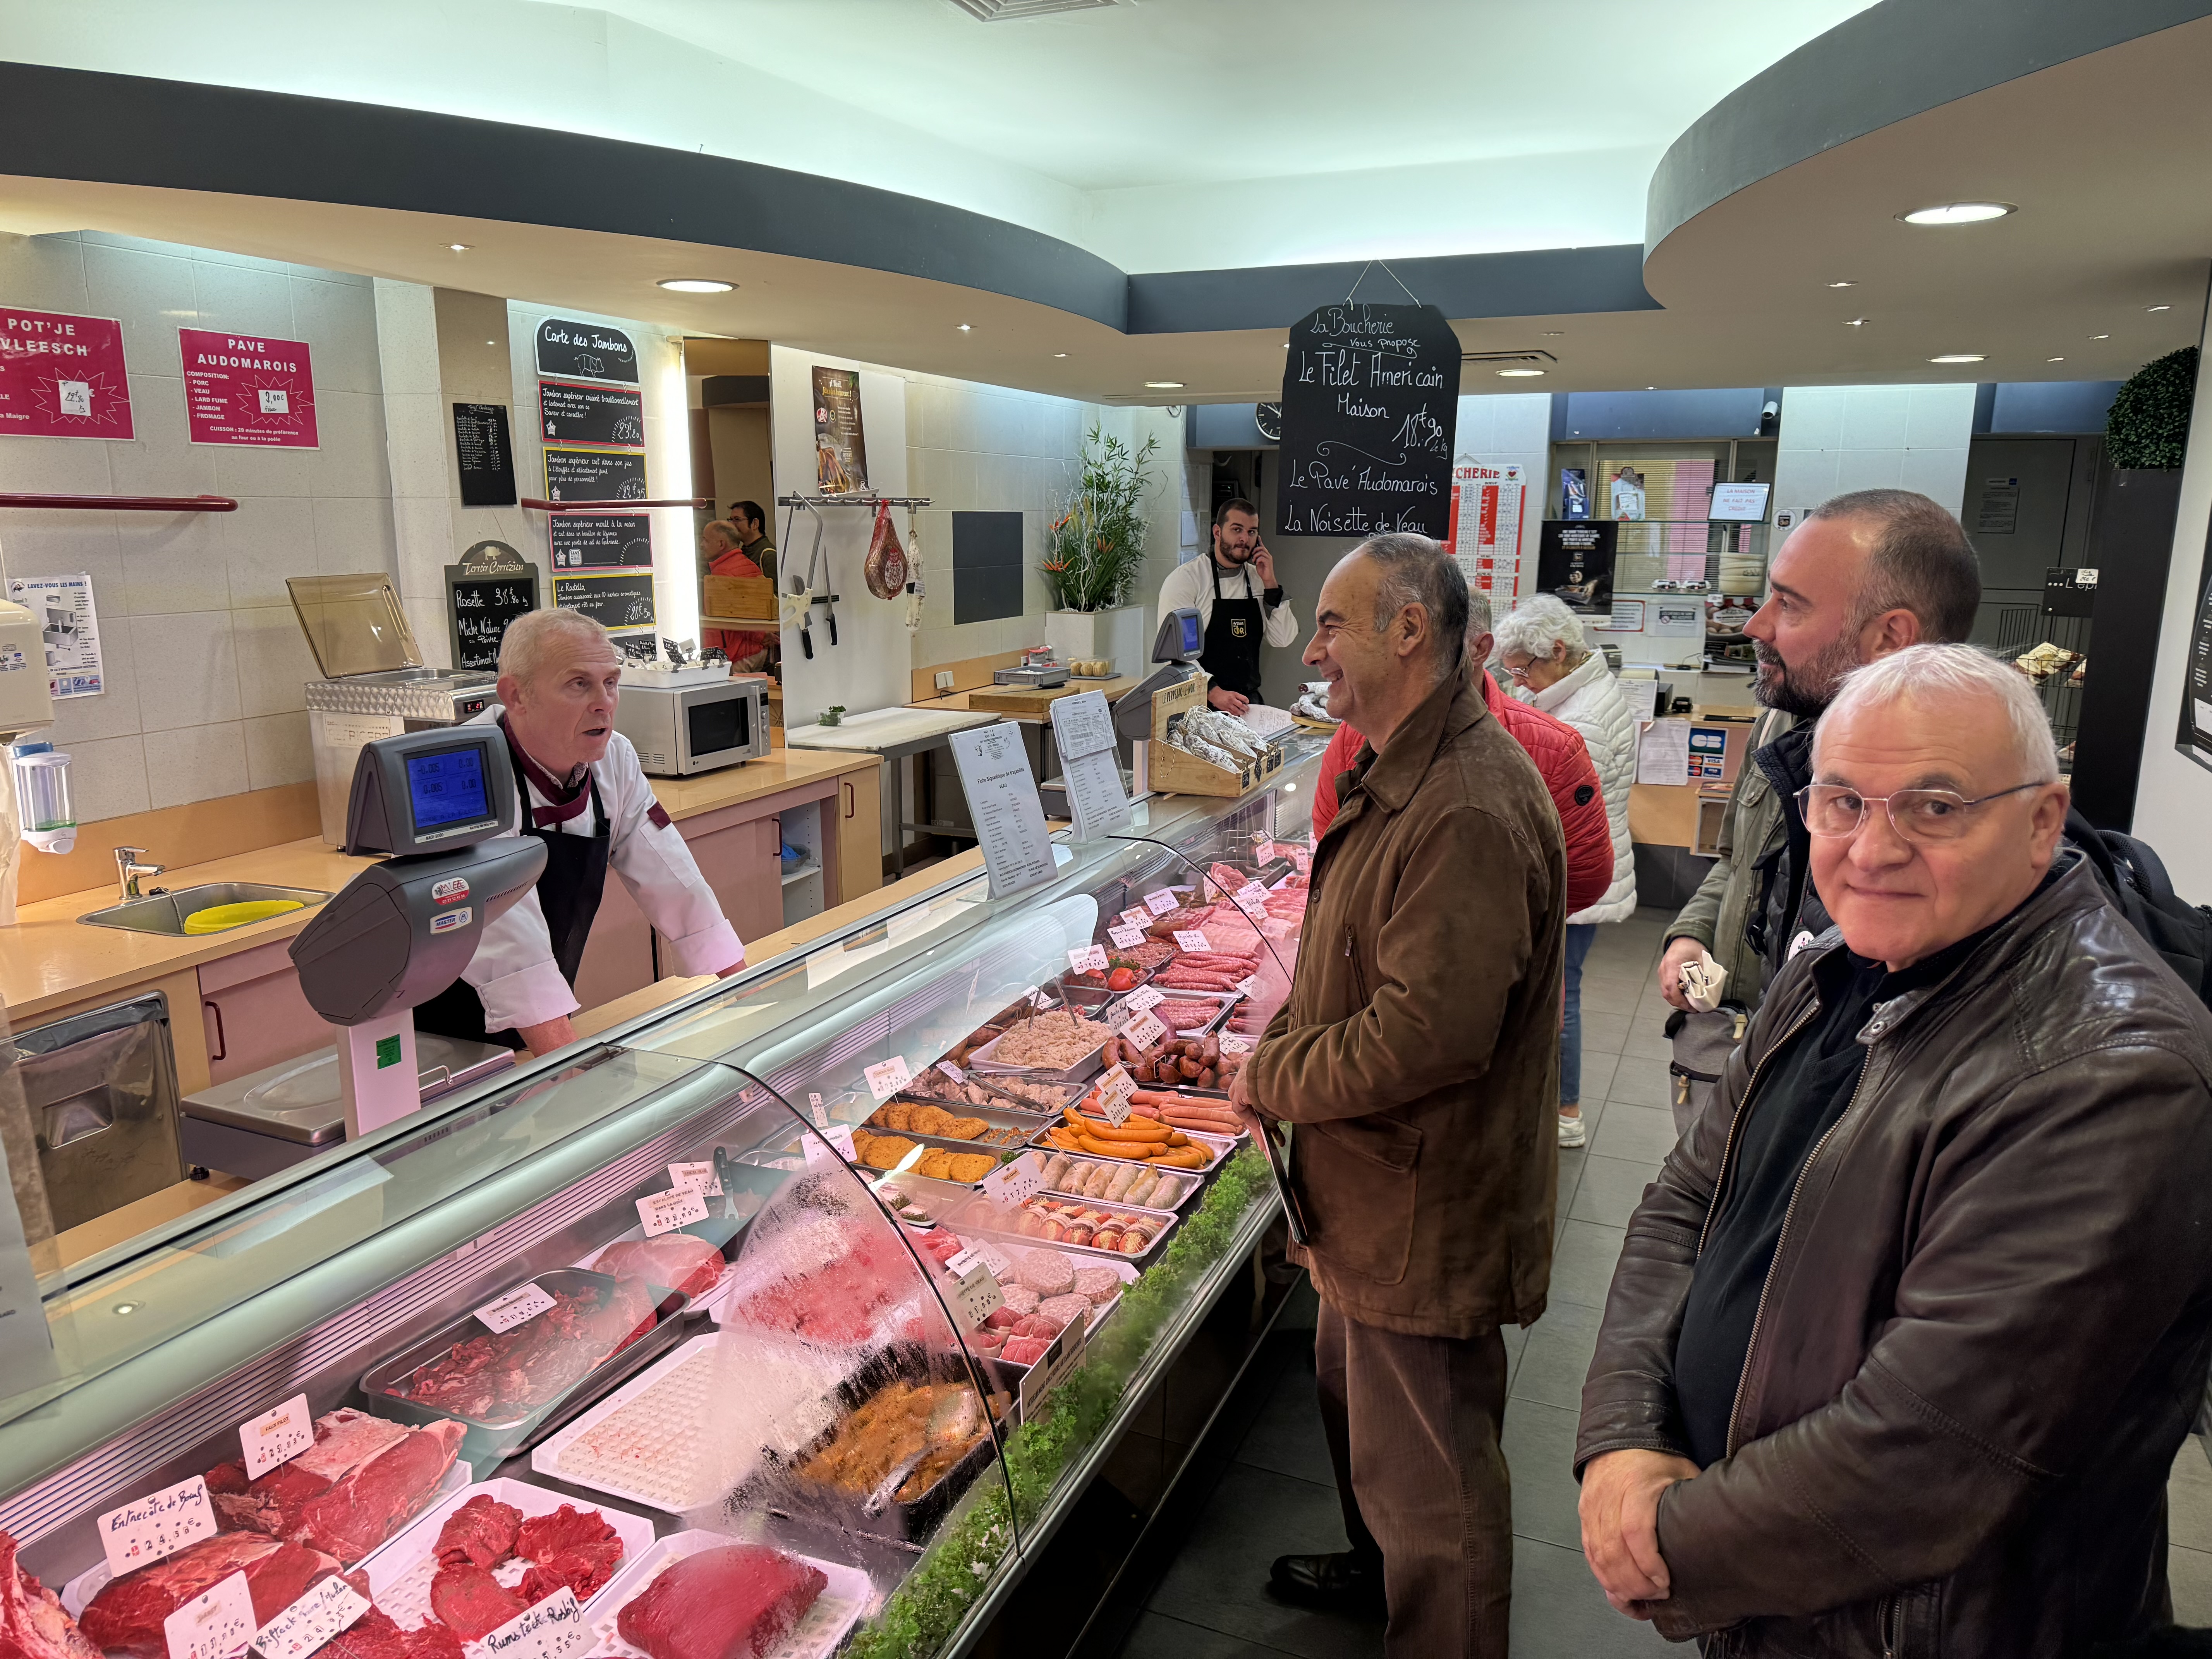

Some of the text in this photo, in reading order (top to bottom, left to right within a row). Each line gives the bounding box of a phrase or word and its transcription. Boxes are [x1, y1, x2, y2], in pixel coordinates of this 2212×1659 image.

[1310, 304, 1394, 336] La Boucherie
[228, 339, 265, 352] PAVE
[545, 326, 627, 353] Carte des Jambons
[0, 338, 88, 356] VLEESCH
[198, 354, 297, 373] AUDOMAROIS
[1299, 351, 1314, 383] Le
[1316, 349, 1360, 386] Filet
[187, 371, 229, 380] COMPOSITION:
[543, 388, 562, 398] Jambon
[563, 392, 584, 402] supérieur
[1338, 392, 1389, 418] Maison
[548, 454, 567, 463] Jambon
[568, 457, 589, 467] supérieur
[1290, 459, 1308, 488] Le
[1358, 467, 1438, 495] Audomarois
[553, 519, 571, 527] Jambon
[1285, 500, 1303, 532] La
[1310, 503, 1370, 532] Noisette
[1375, 512, 1390, 532] de
[462, 562, 489, 575] Terroir
[557, 582, 564, 592] Le
[456, 589, 485, 608] Rosette
[481, 617, 501, 634] Nature
[477, 635, 498, 643] Poivre
[462, 779, 476, 790] 0.00
[436, 918, 455, 926] MASTER
[1004, 1170, 1017, 1181] MELONA
[653, 1195, 675, 1204] ESCALOPE
[975, 1276, 985, 1285] VEAU
[1027, 1381, 1045, 1409] ACTUELLEMENT
[1060, 1350, 1070, 1367] ARTISAN
[1070, 1338, 1081, 1355] BOUCHER
[277, 1416, 289, 1425] FILET
[112, 1502, 165, 1532] Entrecôte
[167, 1496, 176, 1508] de
[256, 1617, 296, 1654] Bifteck
